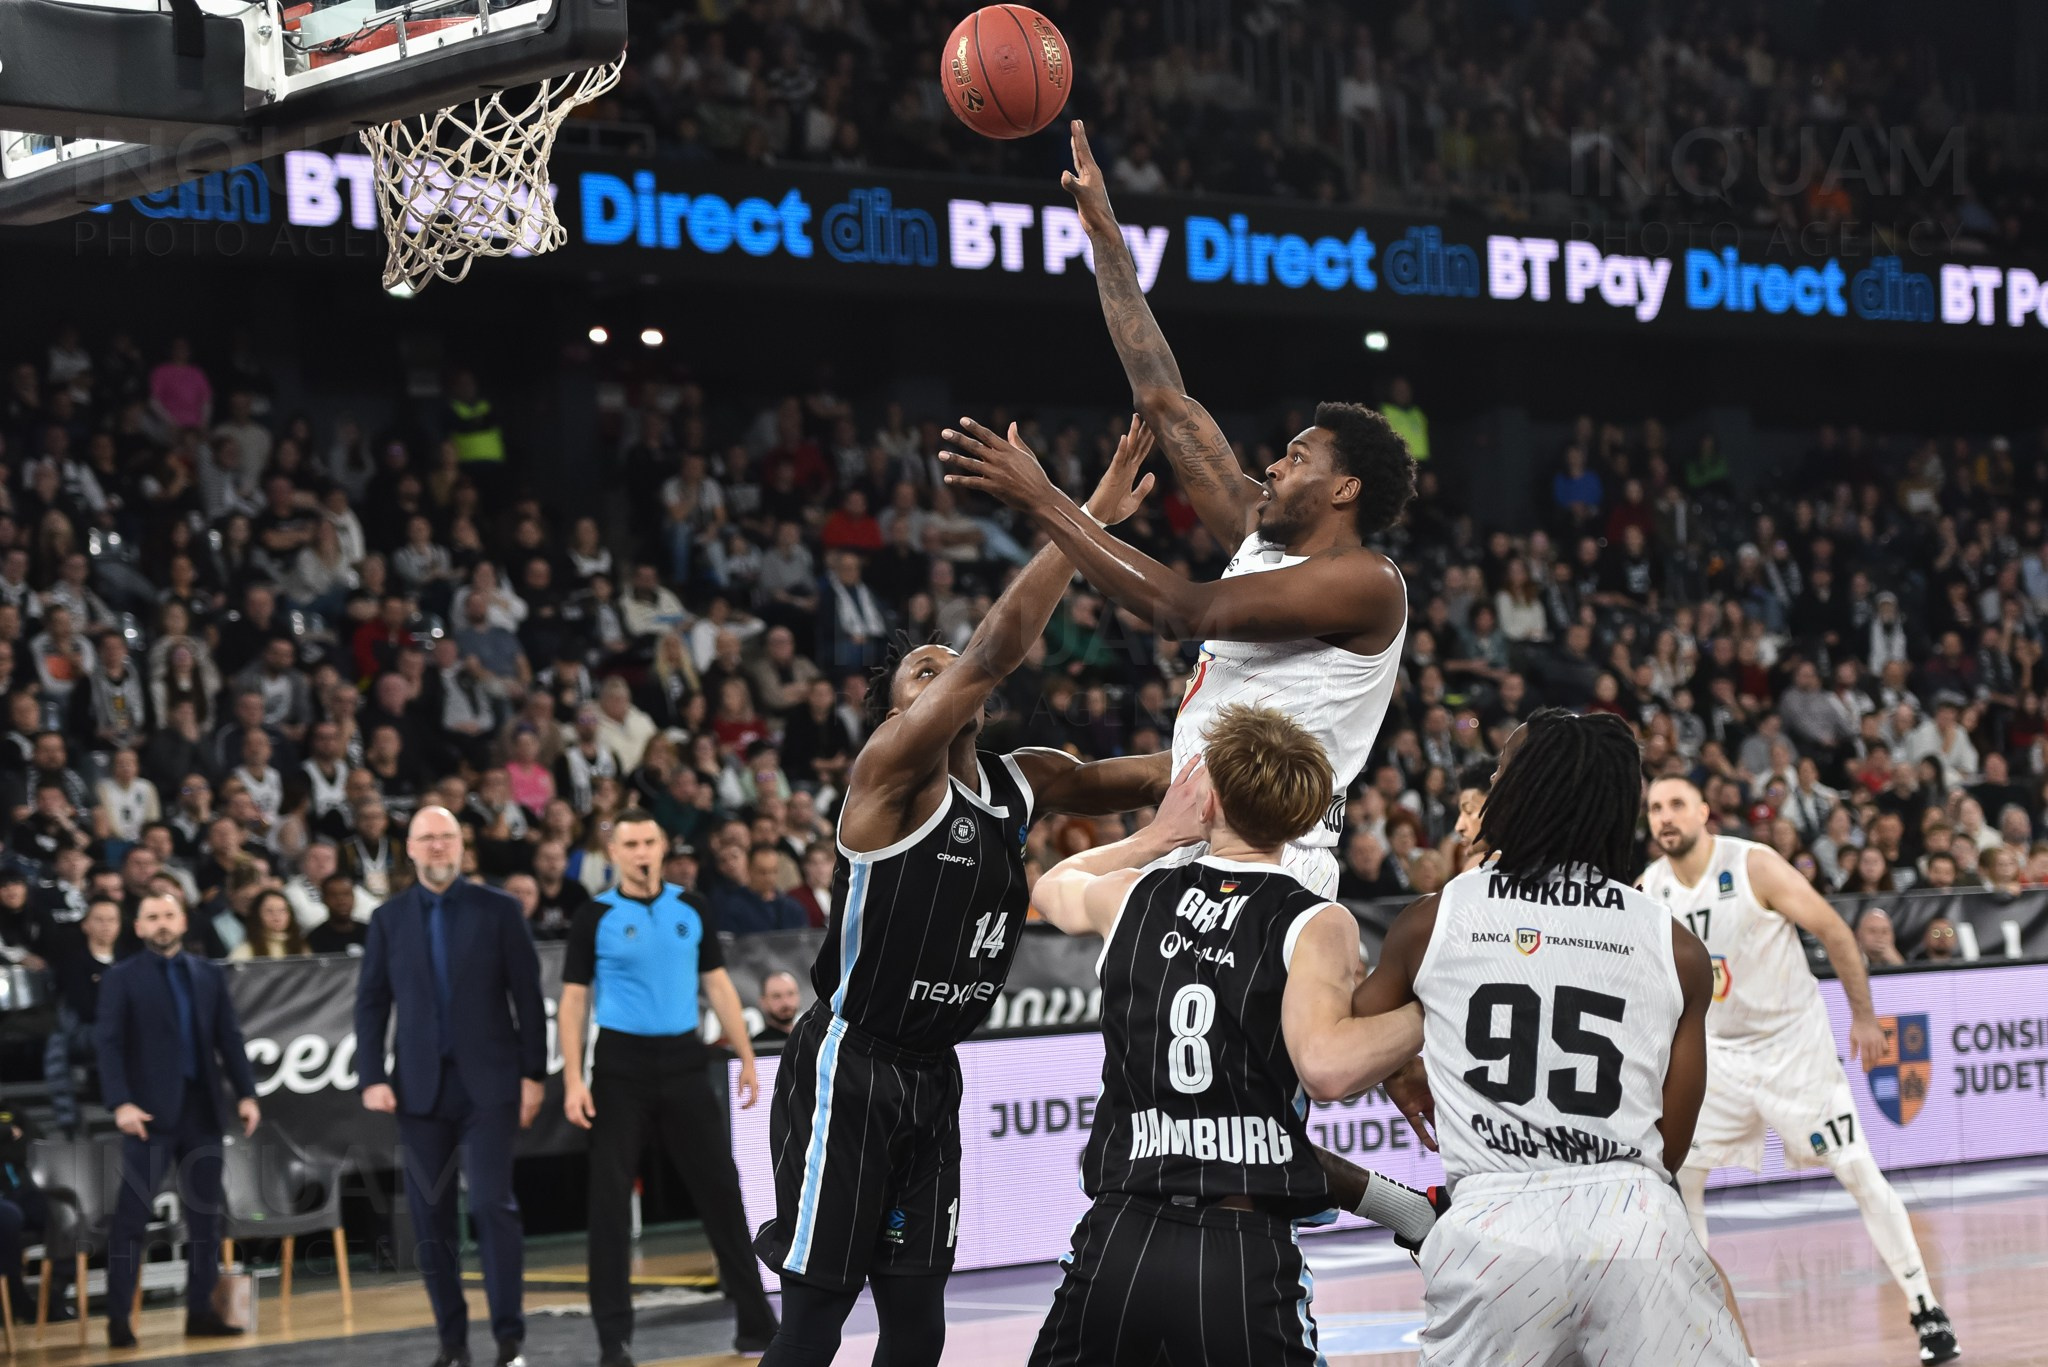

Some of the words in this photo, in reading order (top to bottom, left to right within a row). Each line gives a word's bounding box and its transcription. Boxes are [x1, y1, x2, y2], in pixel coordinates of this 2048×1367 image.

[284, 150, 385, 231] BT
[578, 170, 814, 259] Direct
[821, 187, 938, 267] din
[948, 199, 1034, 272] BT
[1042, 205, 1170, 294] Py
[1184, 213, 1379, 292] Direct
[1381, 225, 1480, 298] din
[1487, 235, 1559, 301] BT
[1564, 240, 1672, 323] Pay
[1684, 246, 1848, 317] Direct
[1852, 255, 1935, 323] din
[1940, 263, 2003, 326] BT
[936, 852, 968, 865] CRAFT
[1488, 873, 1626, 911] MOKOKA
[969, 911, 1009, 959] 14
[1471, 932, 1511, 943] BANCA
[1520, 933, 1536, 944] BT
[1686, 908, 1711, 942] 17
[1168, 983, 1217, 1094] 8
[1463, 982, 1627, 1120] 95
[1129, 1107, 1294, 1165] HAMBURG
[1313, 1116, 1427, 1158] JUDE
[1825, 1113, 1855, 1147] 17
[946, 1197, 959, 1248] 1
